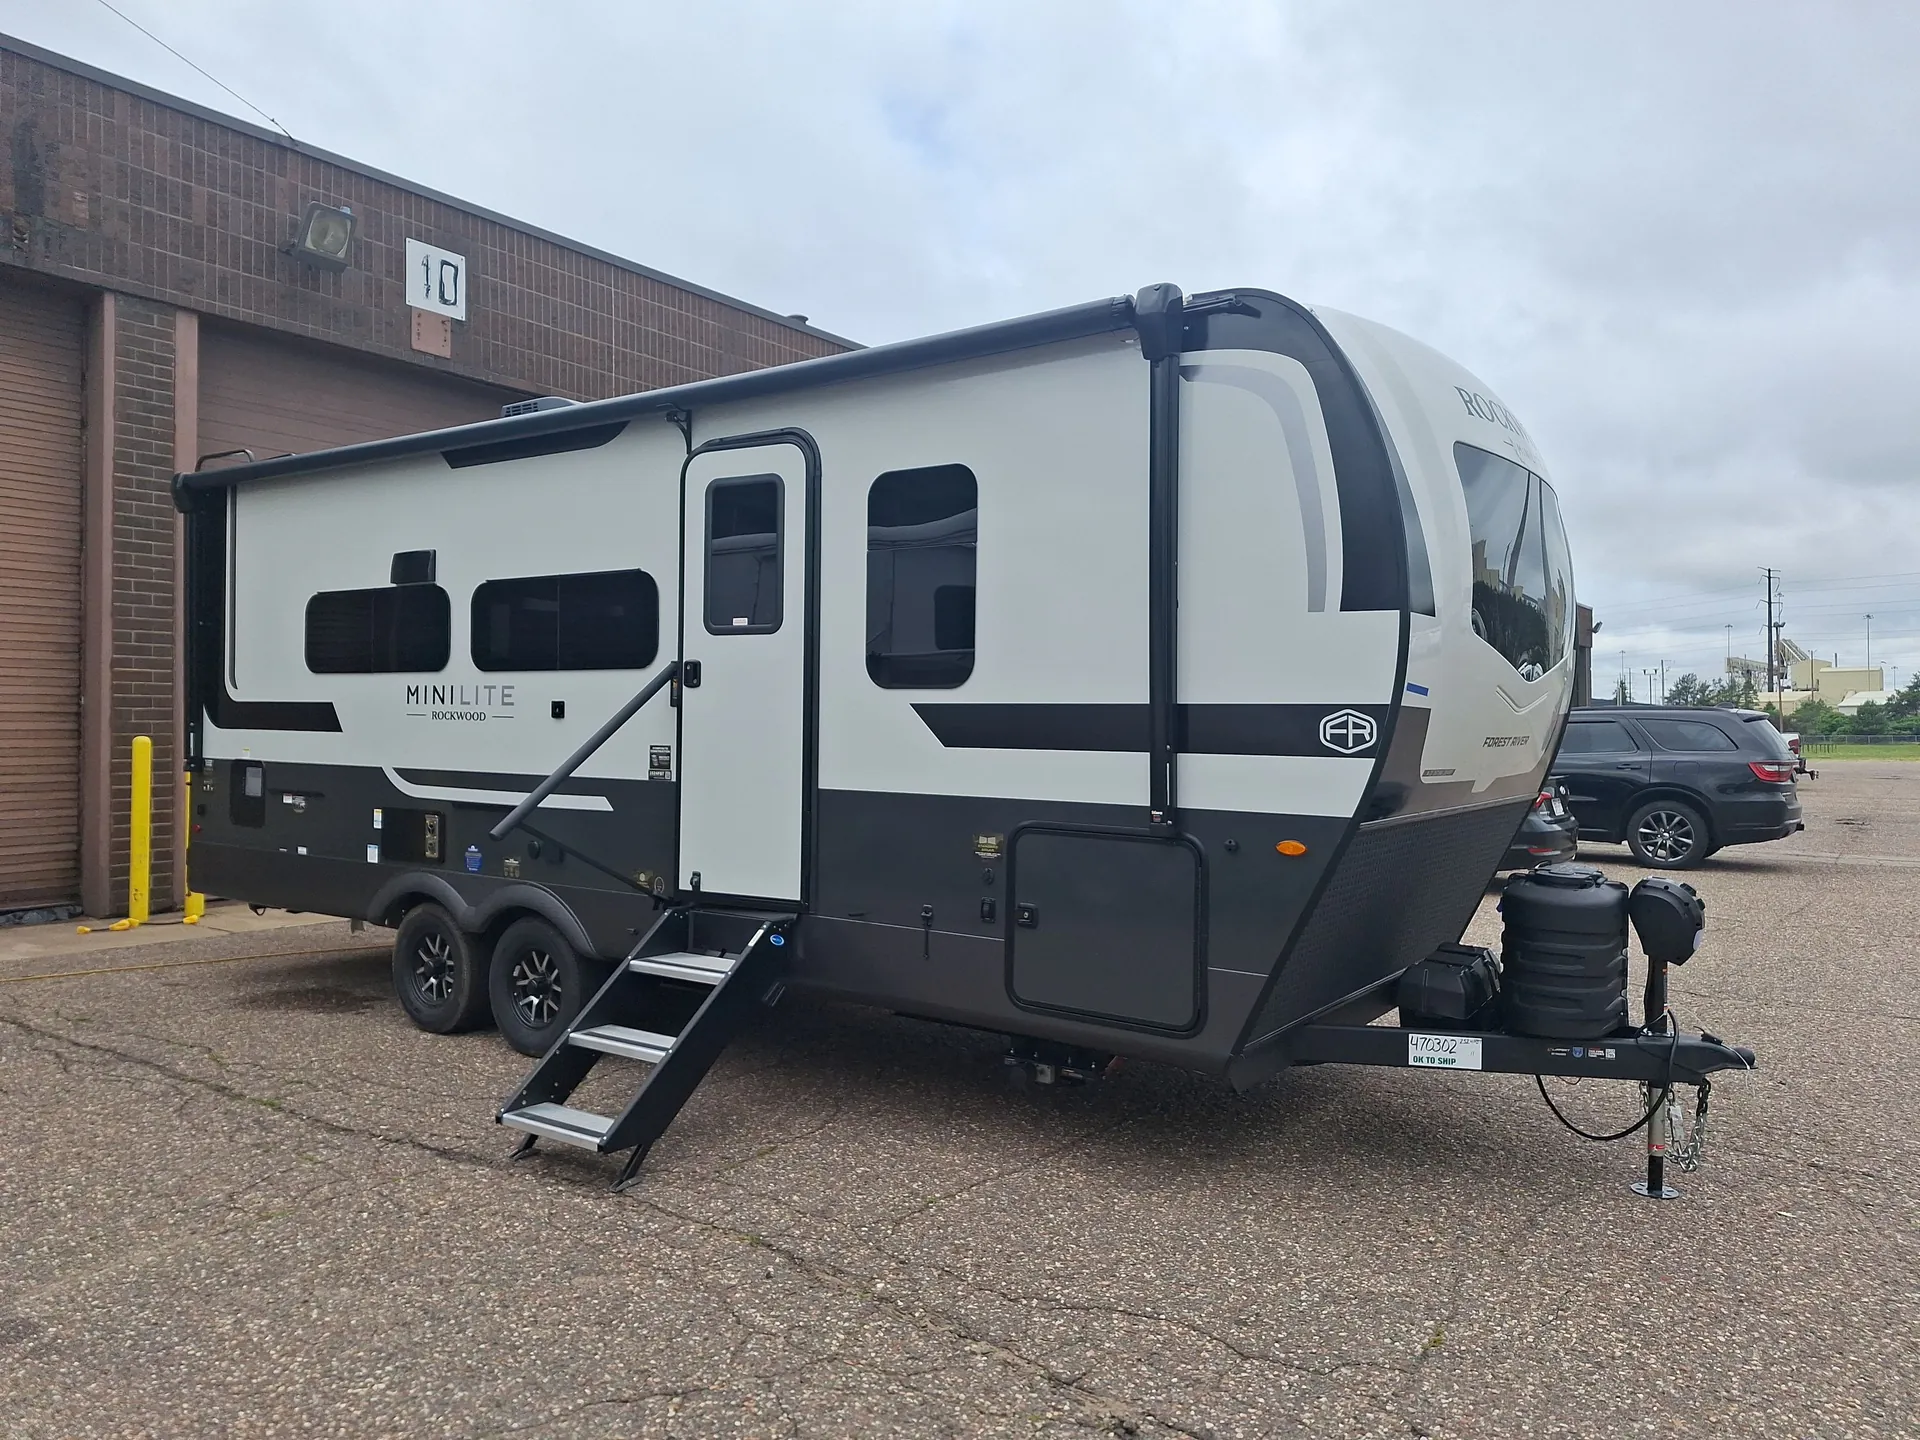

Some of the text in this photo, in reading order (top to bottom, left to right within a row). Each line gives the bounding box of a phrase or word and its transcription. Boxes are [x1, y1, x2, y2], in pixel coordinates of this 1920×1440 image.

[421, 254, 459, 306] 10
[406, 684, 515, 706] MINILITE
[431, 710, 487, 722] ROCKWOOD
[1482, 735, 1530, 748] FOREST RIVER
[1410, 1035, 1457, 1054] 470302
[1412, 1055, 1457, 1066] OK TO SHIP
